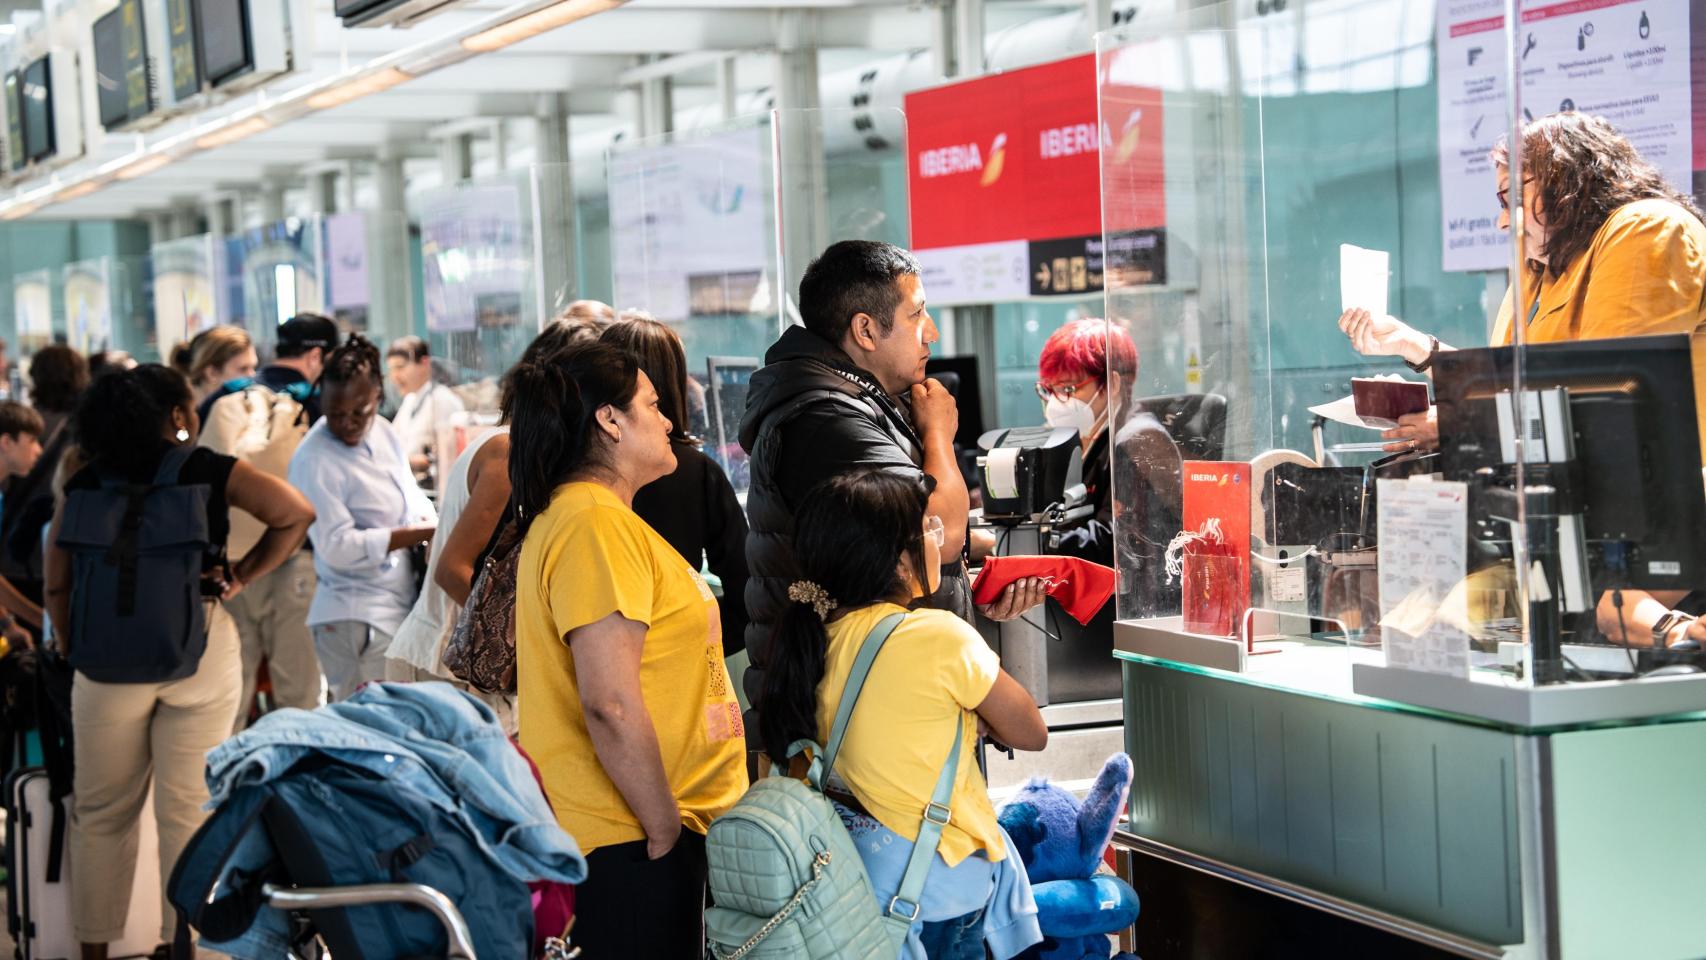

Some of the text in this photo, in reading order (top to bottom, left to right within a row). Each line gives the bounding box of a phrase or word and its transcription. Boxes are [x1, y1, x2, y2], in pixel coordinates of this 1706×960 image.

[1040, 122, 1113, 159] IBERIA
[918, 143, 982, 178] IBERIA
[1191, 473, 1217, 482] IBERIA
